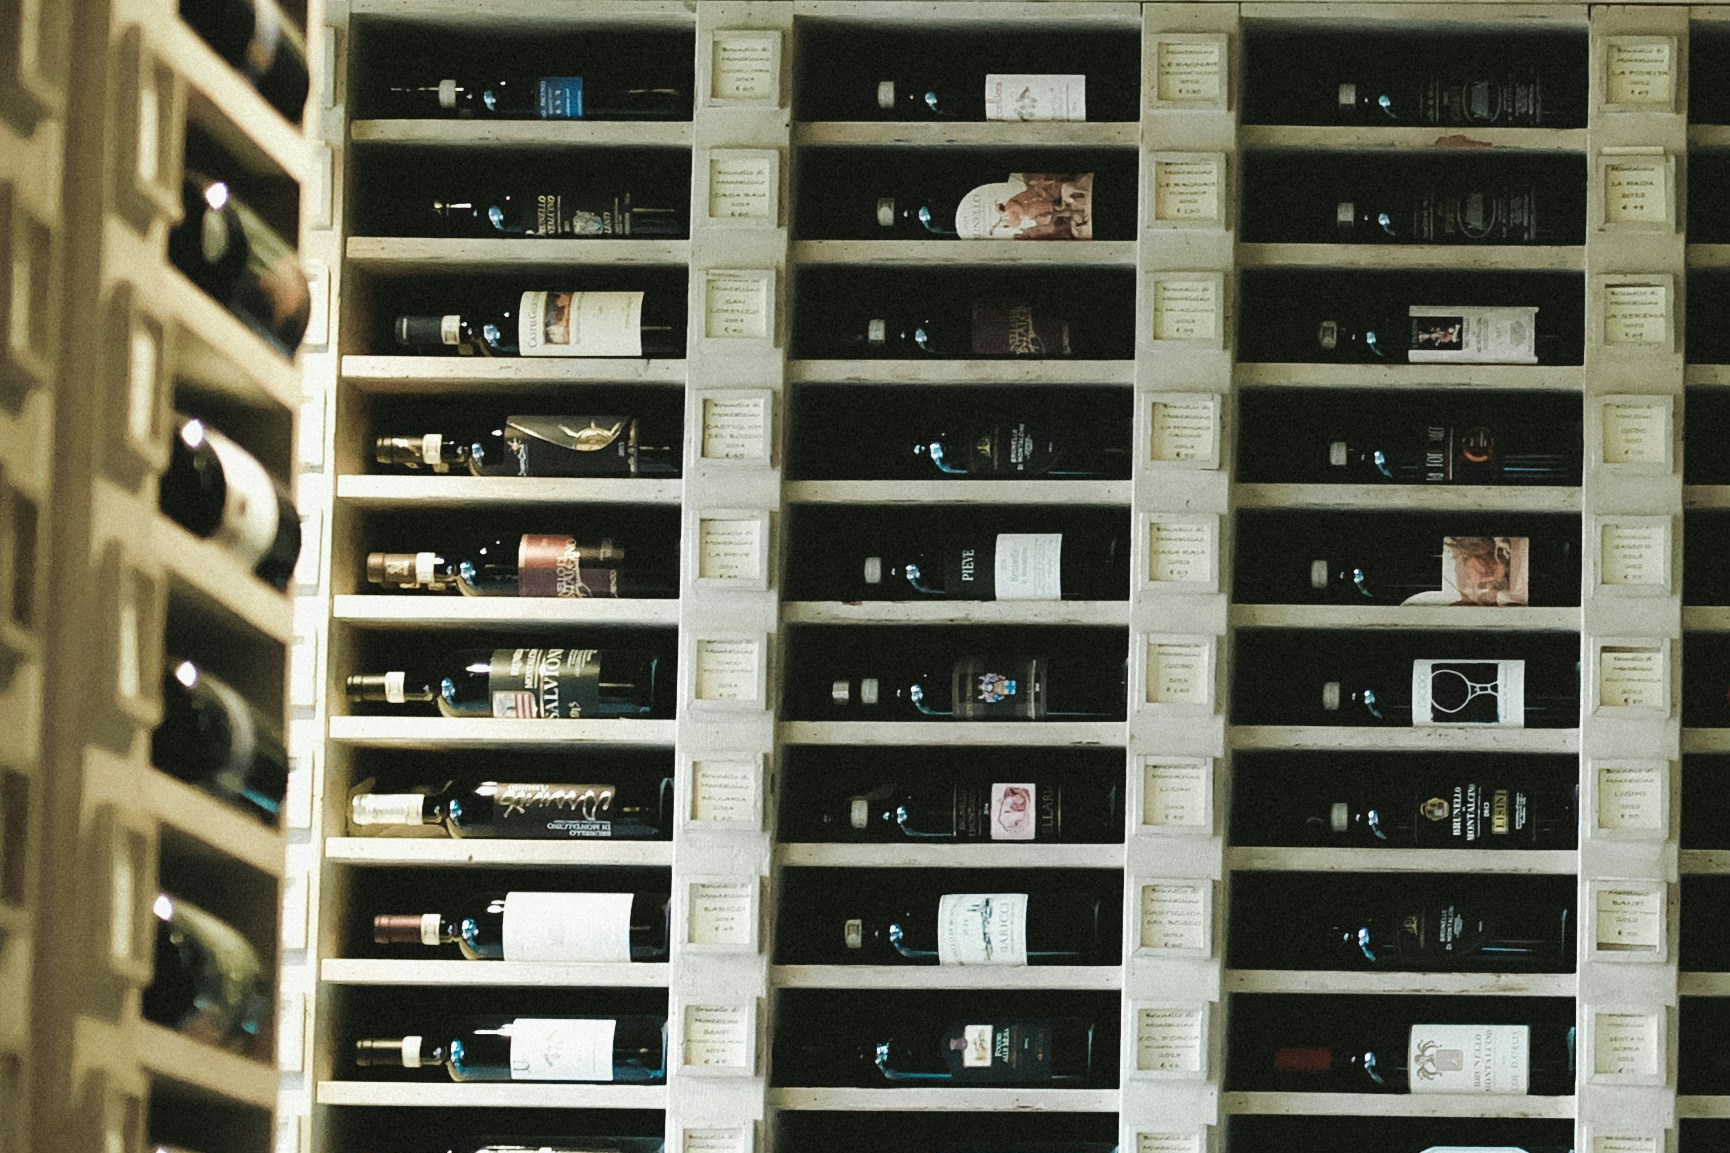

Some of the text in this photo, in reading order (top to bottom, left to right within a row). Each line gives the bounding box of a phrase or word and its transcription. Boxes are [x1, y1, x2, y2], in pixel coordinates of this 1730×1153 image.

[962, 549, 975, 581] PIEVE
[544, 648, 561, 720] SALVION
[1453, 786, 1462, 836] BRUNELLO
[1467, 783, 1476, 841] MONTALCINO
